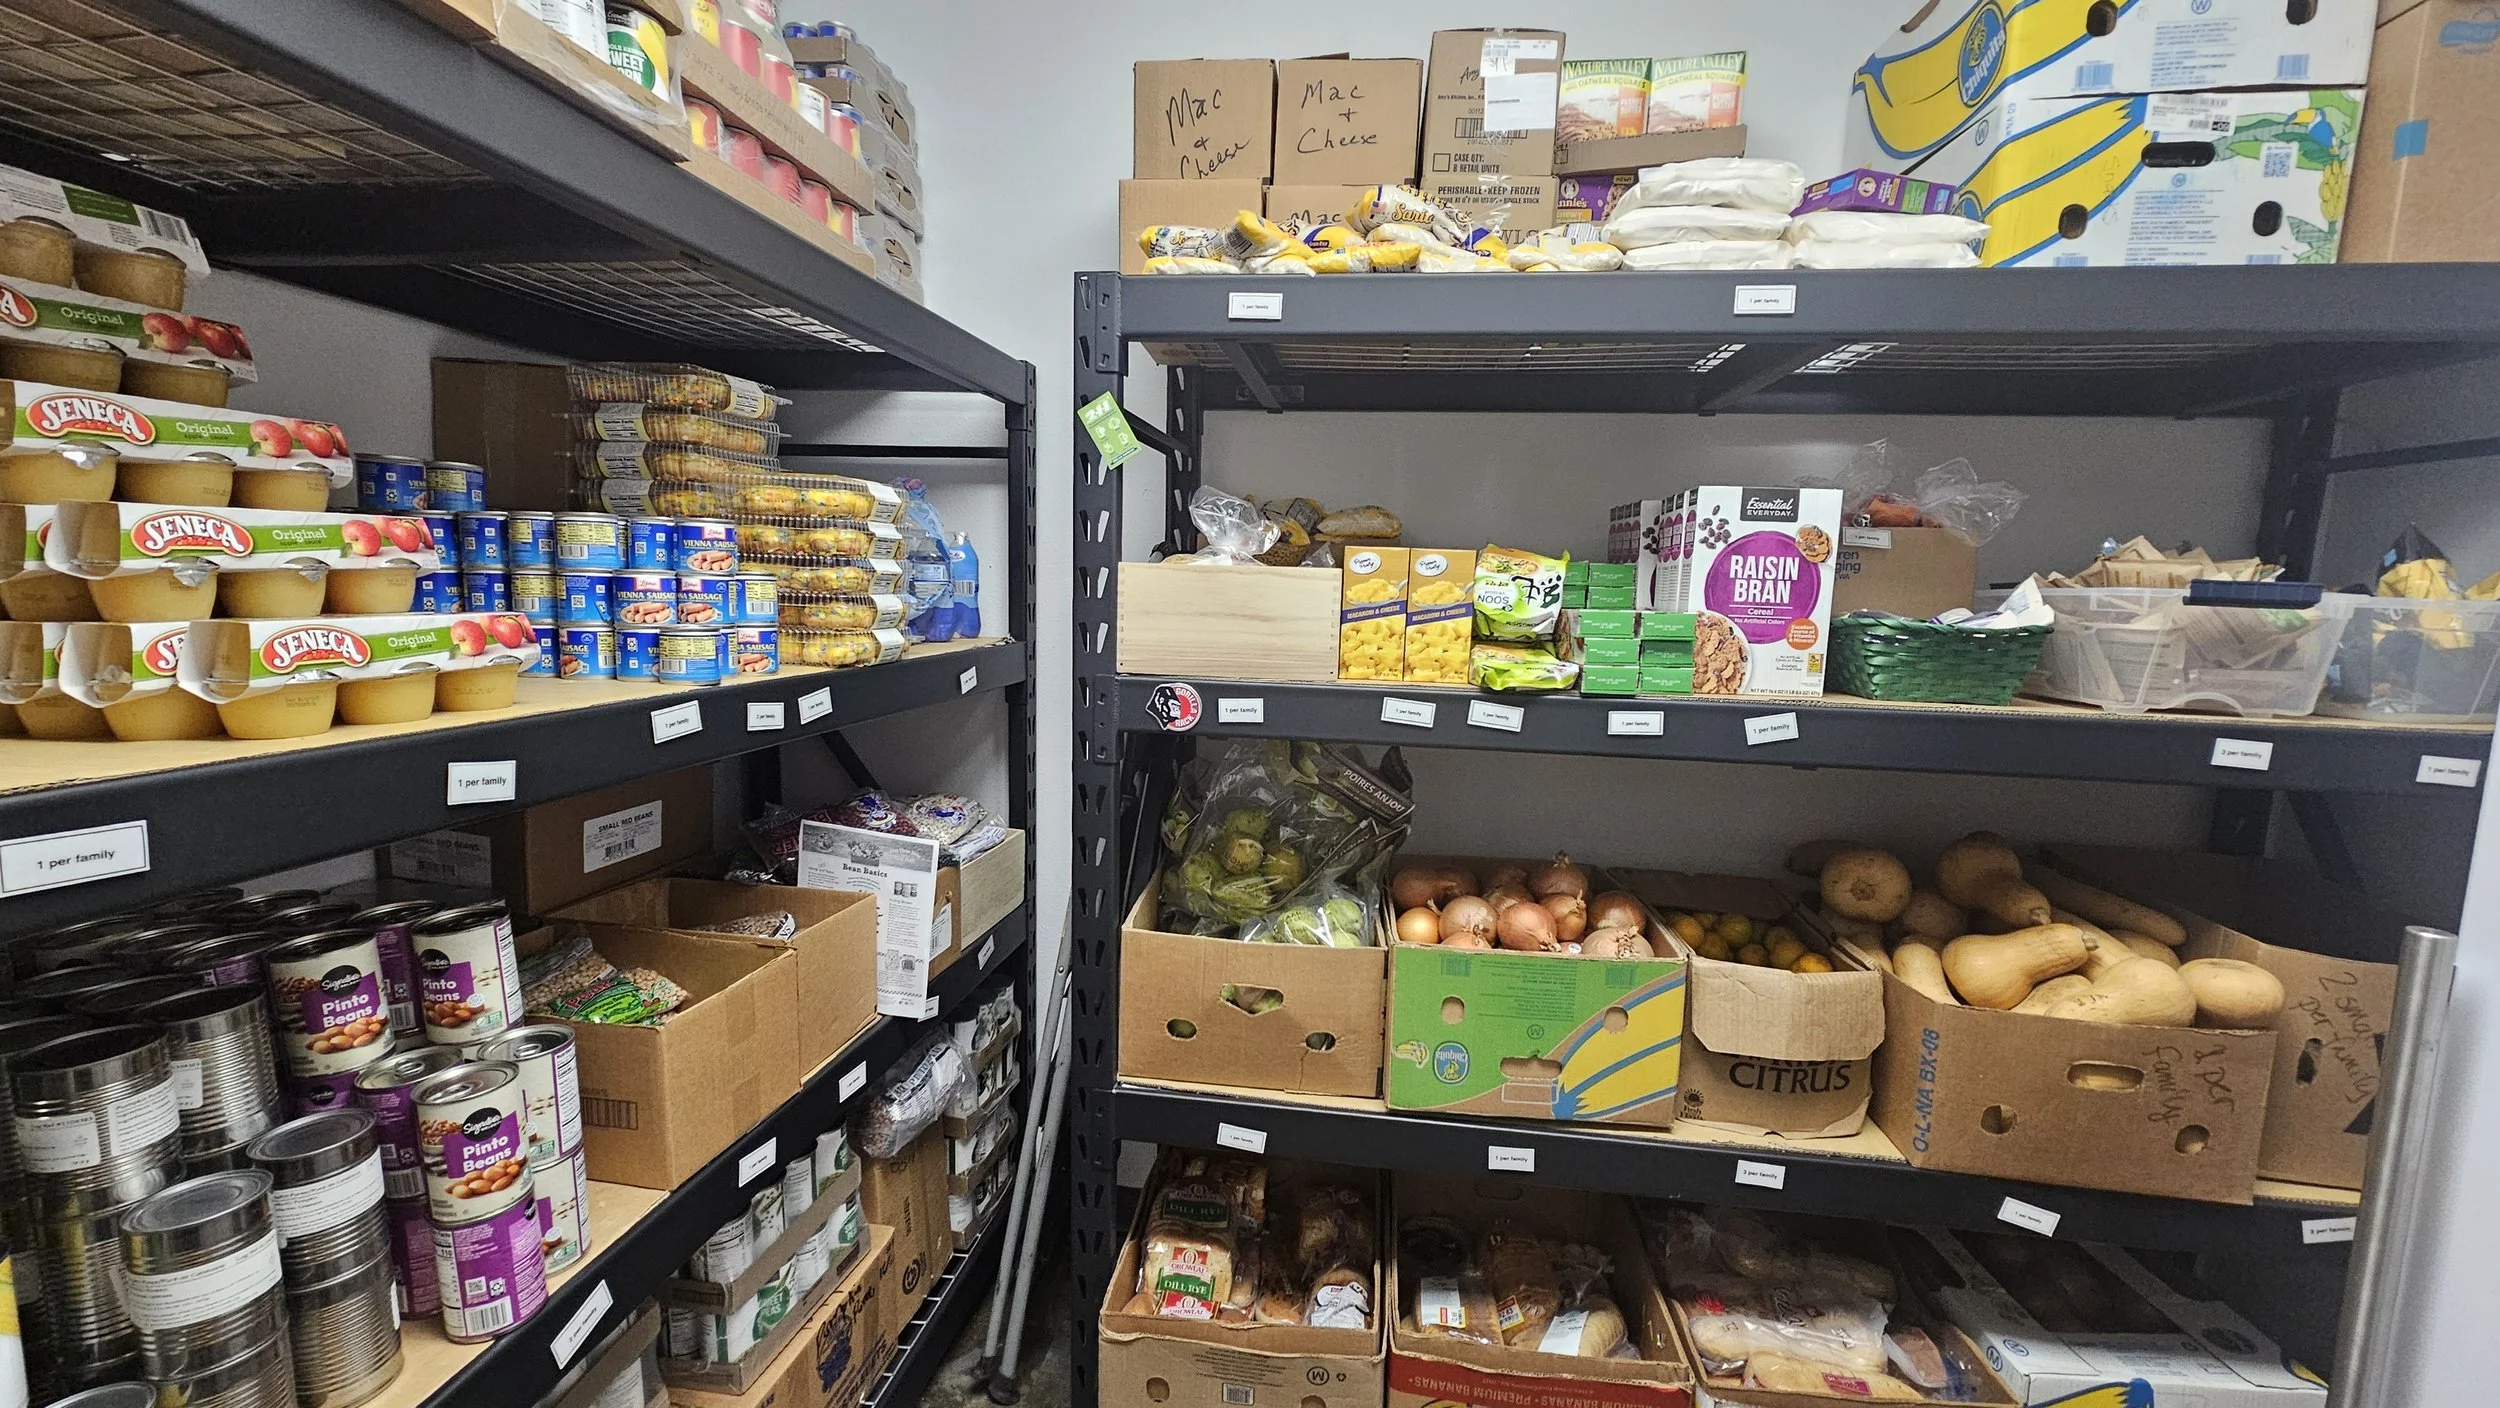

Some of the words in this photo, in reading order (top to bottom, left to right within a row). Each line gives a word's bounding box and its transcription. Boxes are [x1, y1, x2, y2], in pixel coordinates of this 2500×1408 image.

[1564, 60, 1608, 79] NATURE
[1608, 58, 1651, 76] VALLEY
[1654, 57, 1698, 79] NATURE
[1699, 52, 1745, 69] VALLEY
[1962, 29, 2005, 104] Chiquita
[1301, 79, 1365, 109] Mac
[1166, 88, 1221, 146] Mac
[1339, 107, 1358, 123] +
[1297, 128, 1379, 154] Cheese
[1453, 153, 1469, 162] CASE
[1471, 153, 1485, 163] QTY:
[1460, 164, 1480, 173] RETAIL
[1481, 165, 1500, 173] UNITS
[1438, 186, 1483, 195] PERISHABLE
[1487, 186, 1507, 195] KEEP
[1510, 186, 1541, 195] FROZEN
[1558, 197, 1588, 208] nnie's
[61, 306, 124, 326] Original
[41, 396, 146, 442] SENECA
[176, 421, 234, 437] Original
[1746, 497, 1794, 510] Essential
[143, 515, 239, 554] SENECA
[272, 527, 327, 544] Original
[683, 539, 712, 548] VIENNA
[1729, 555, 1800, 580] RAISIN
[617, 591, 645, 599] VIENNA
[688, 592, 723, 600] SAUSAGE
[1733, 579, 1791, 604] BRAN
[1743, 617, 1767, 625] Artificial
[1747, 608, 1774, 616] Cereal
[270, 630, 360, 667] SENECA
[387, 631, 438, 650] Original
[745, 643, 776, 651] SAUSAGE
[1175, 687, 1199, 714] GORILLA
[1175, 714, 1195, 728] RACK
[1770, 724, 1789, 732] family
[2240, 751, 2262, 759] family
[2447, 768, 2470, 776] family
[465, 778, 480, 789] per
[482, 777, 507, 787] family
[1344, 769, 1376, 794] POIRES
[1374, 790, 1405, 812] ANJOU
[599, 822, 620, 832] SMALL
[621, 816, 633, 826] RED
[634, 811, 653, 822] BEANS
[49, 857, 72, 870] per
[76, 850, 116, 863] family
[843, 864, 862, 874] Bean
[863, 866, 888, 878] Basics
[422, 979, 457, 989] Pinto
[2318, 971, 2358, 992] 2
[322, 994, 369, 1015] Pinto
[424, 992, 460, 1002] Beans
[322, 1006, 373, 1028] Beans
[2288, 996, 2332, 1034] per
[2323, 1035, 2382, 1104] family
[1729, 1061, 1851, 1094] CITRUS
[2141, 1046, 2191, 1124] family
[2192, 1066, 2235, 1116] per
[462, 1135, 509, 1159] Pinto
[463, 1147, 512, 1173] Beans
[1510, 1155, 1527, 1163] family
[1759, 1172, 1777, 1180] family
[1164, 1280, 1186, 1292] DILL
[1188, 1283, 1208, 1295] RYE
[1413, 1378, 1470, 1395] BANANAS
[1472, 1386, 1534, 1406] PREMIUM
